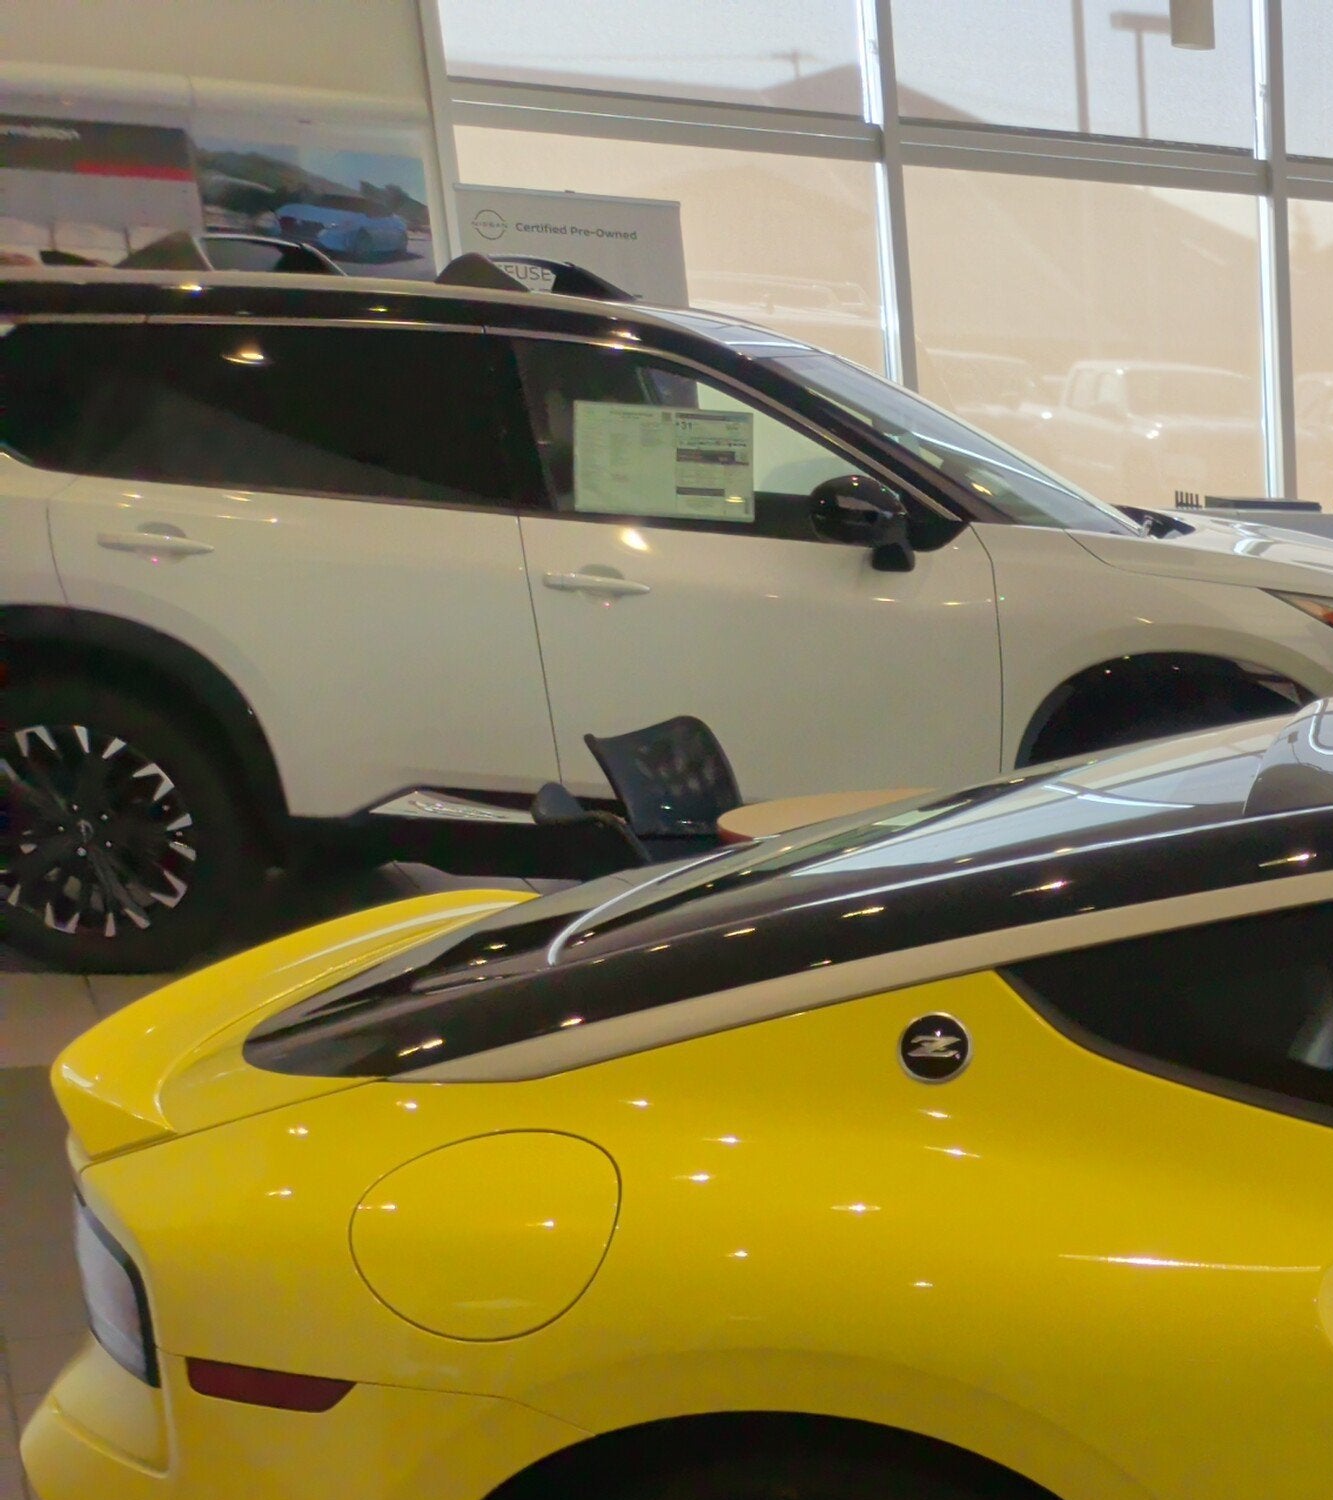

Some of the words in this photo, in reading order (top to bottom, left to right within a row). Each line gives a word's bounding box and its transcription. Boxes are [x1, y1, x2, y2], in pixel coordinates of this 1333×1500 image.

[515, 222, 568, 235] Certified
[570, 226, 638, 240] Pre-Owned
[499, 264, 552, 281] FUSE
